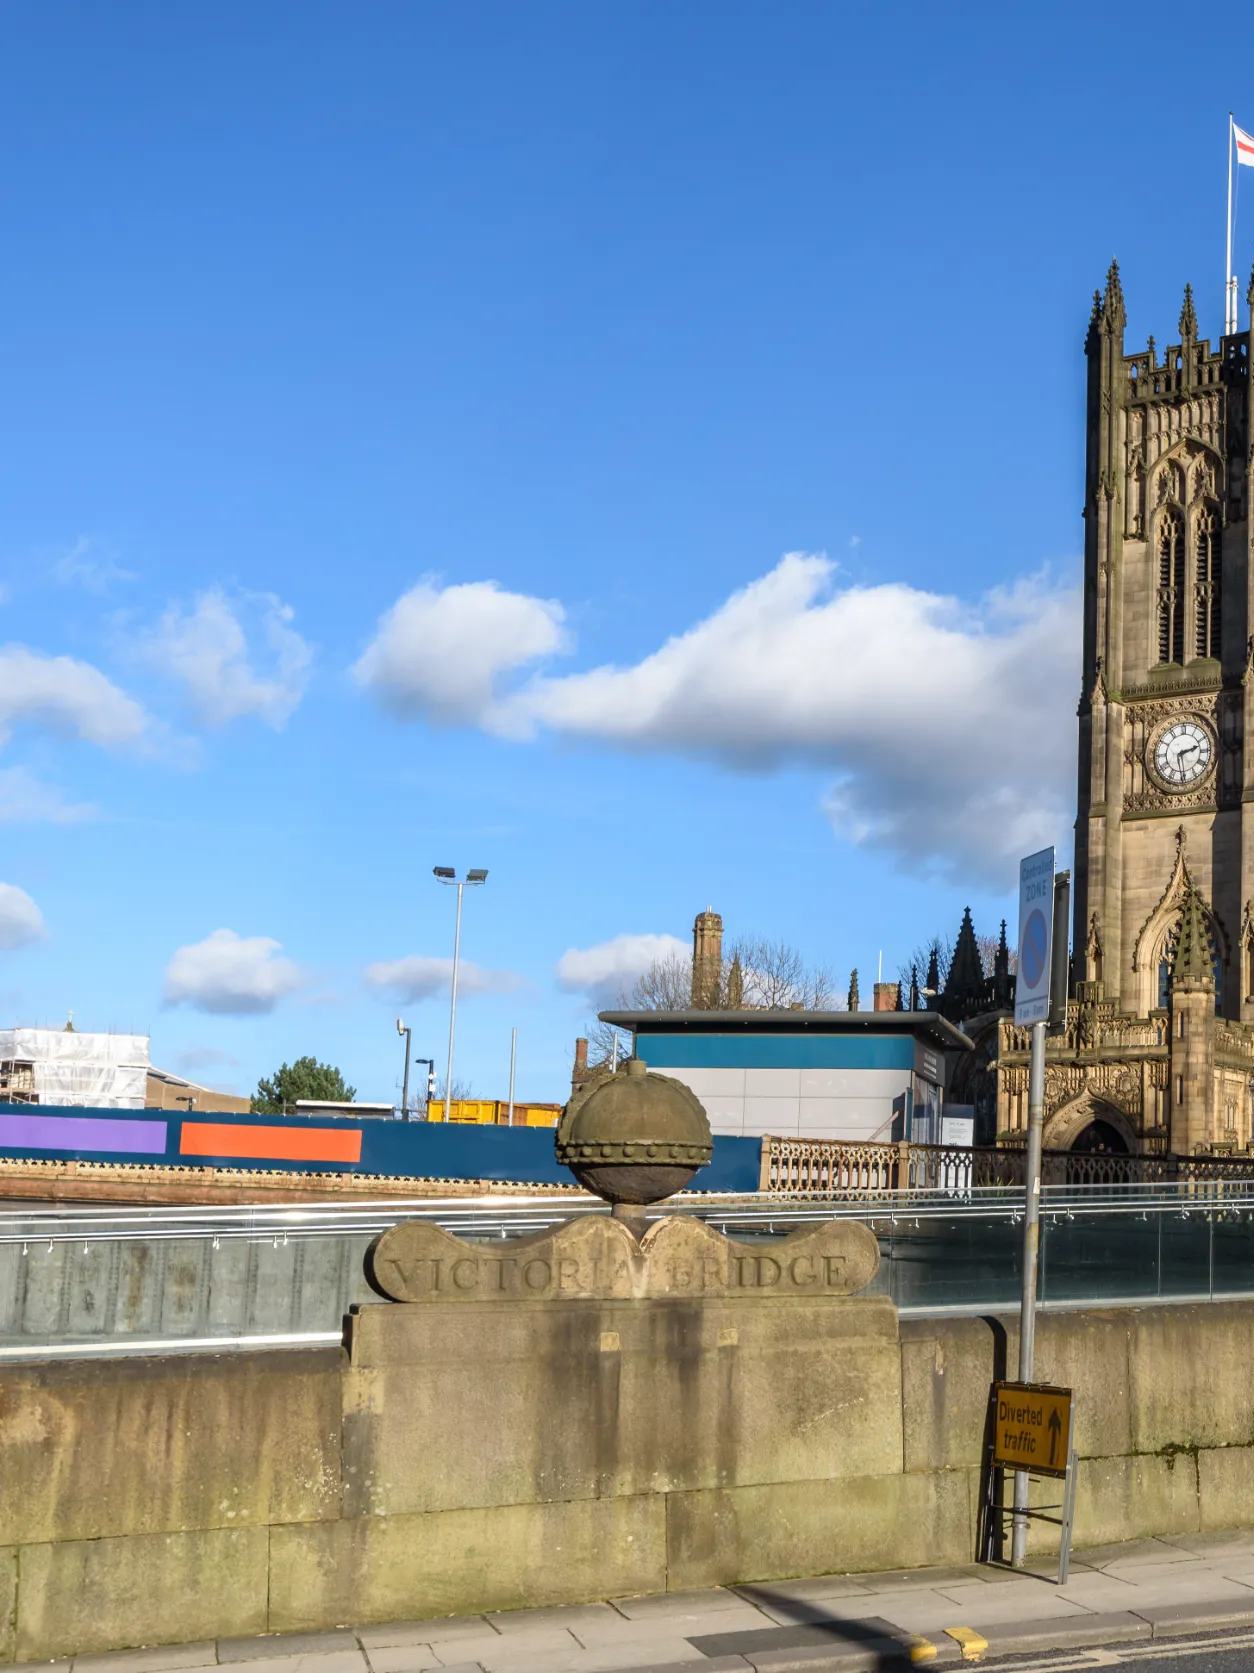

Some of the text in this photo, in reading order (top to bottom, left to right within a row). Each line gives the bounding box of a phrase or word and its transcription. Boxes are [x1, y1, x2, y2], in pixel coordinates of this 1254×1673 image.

[1021, 858, 1052, 882] Controlled
[1026, 879, 1047, 902] ZONE
[384, 1255, 849, 1292] VICTORIA BRIDGE
[1000, 1401, 1043, 1426] Diverted
[1004, 1430, 1036, 1453] traffic
